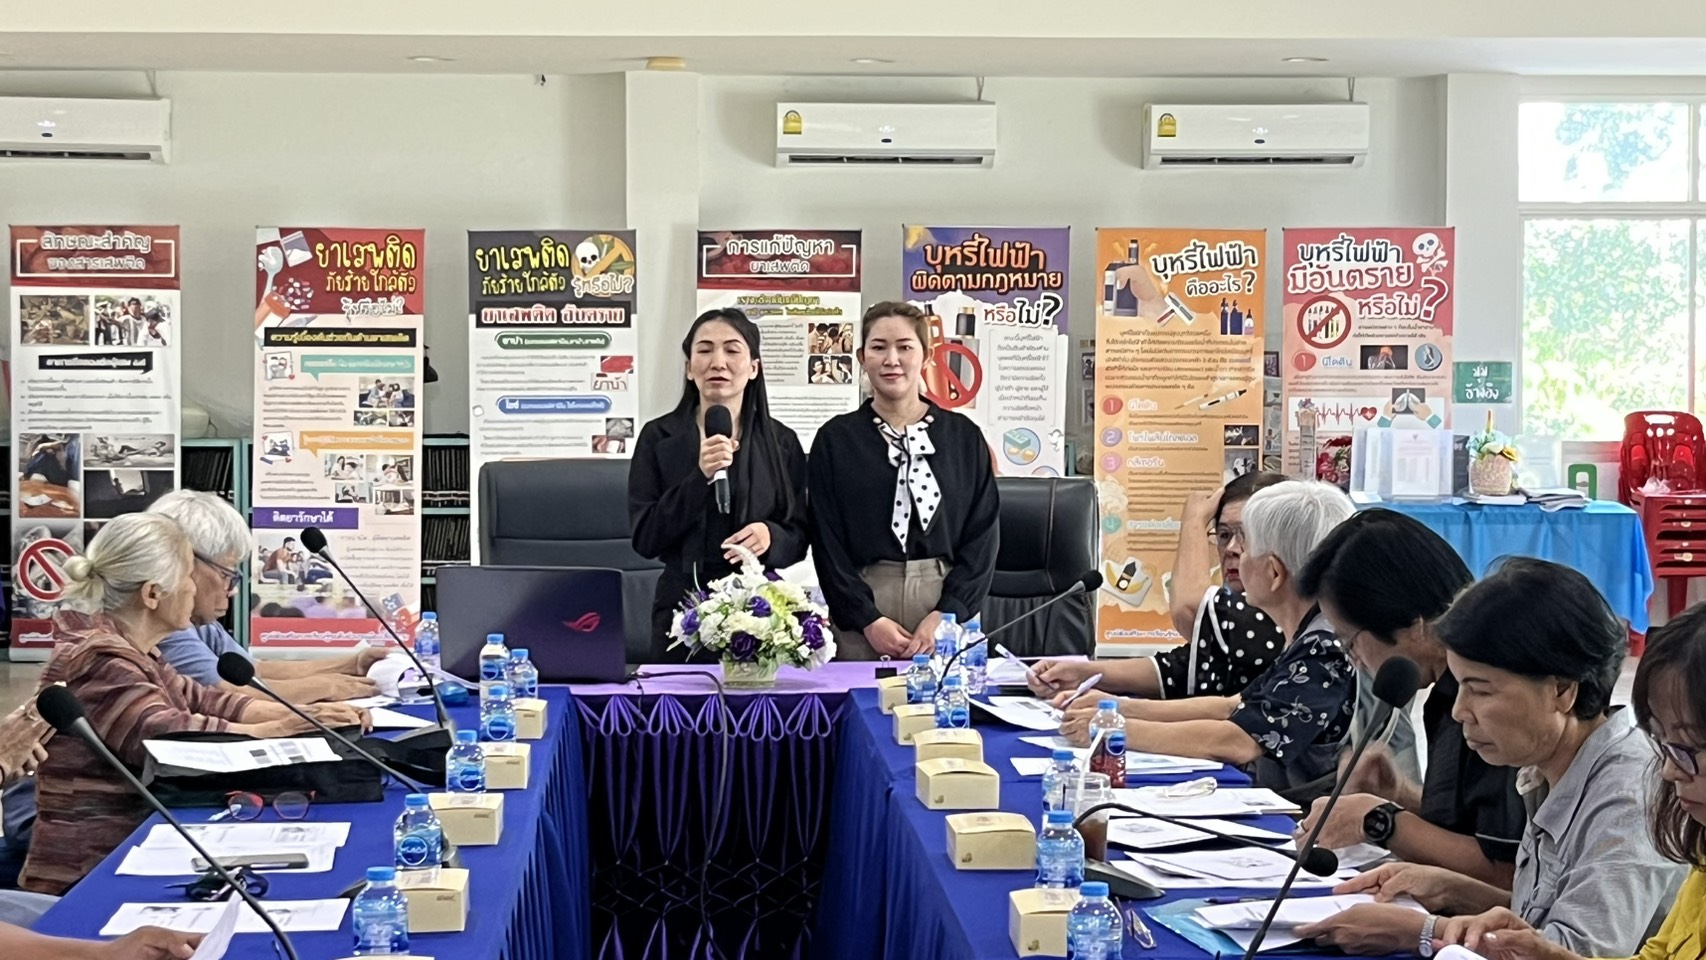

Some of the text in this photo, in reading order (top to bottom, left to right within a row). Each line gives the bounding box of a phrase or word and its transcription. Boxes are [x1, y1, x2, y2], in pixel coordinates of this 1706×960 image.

[41, 229, 152, 253] ลักษณะสำคัญ
[315, 234, 416, 268] ยาเสพติด
[726, 234, 834, 257] การแก้ปัญหา
[925, 233, 1045, 272] บุหรี่ไฟฟ้า
[1298, 234, 1402, 269] บุหรี่ไฟฟ้า
[475, 237, 570, 272] ยาเสพติด
[750, 258, 810, 272] ยาเสพติด
[1151, 241, 1256, 280] บุหรี่ไฟฟ้า
[912, 270, 1062, 293] ผิดตามกฎหมาย
[1290, 263, 1414, 291] มีอันตราย
[481, 304, 625, 323] ยาเสพติด อันตราย
[1106, 431, 1115, 442] 2
[1105, 457, 1115, 468] 3
